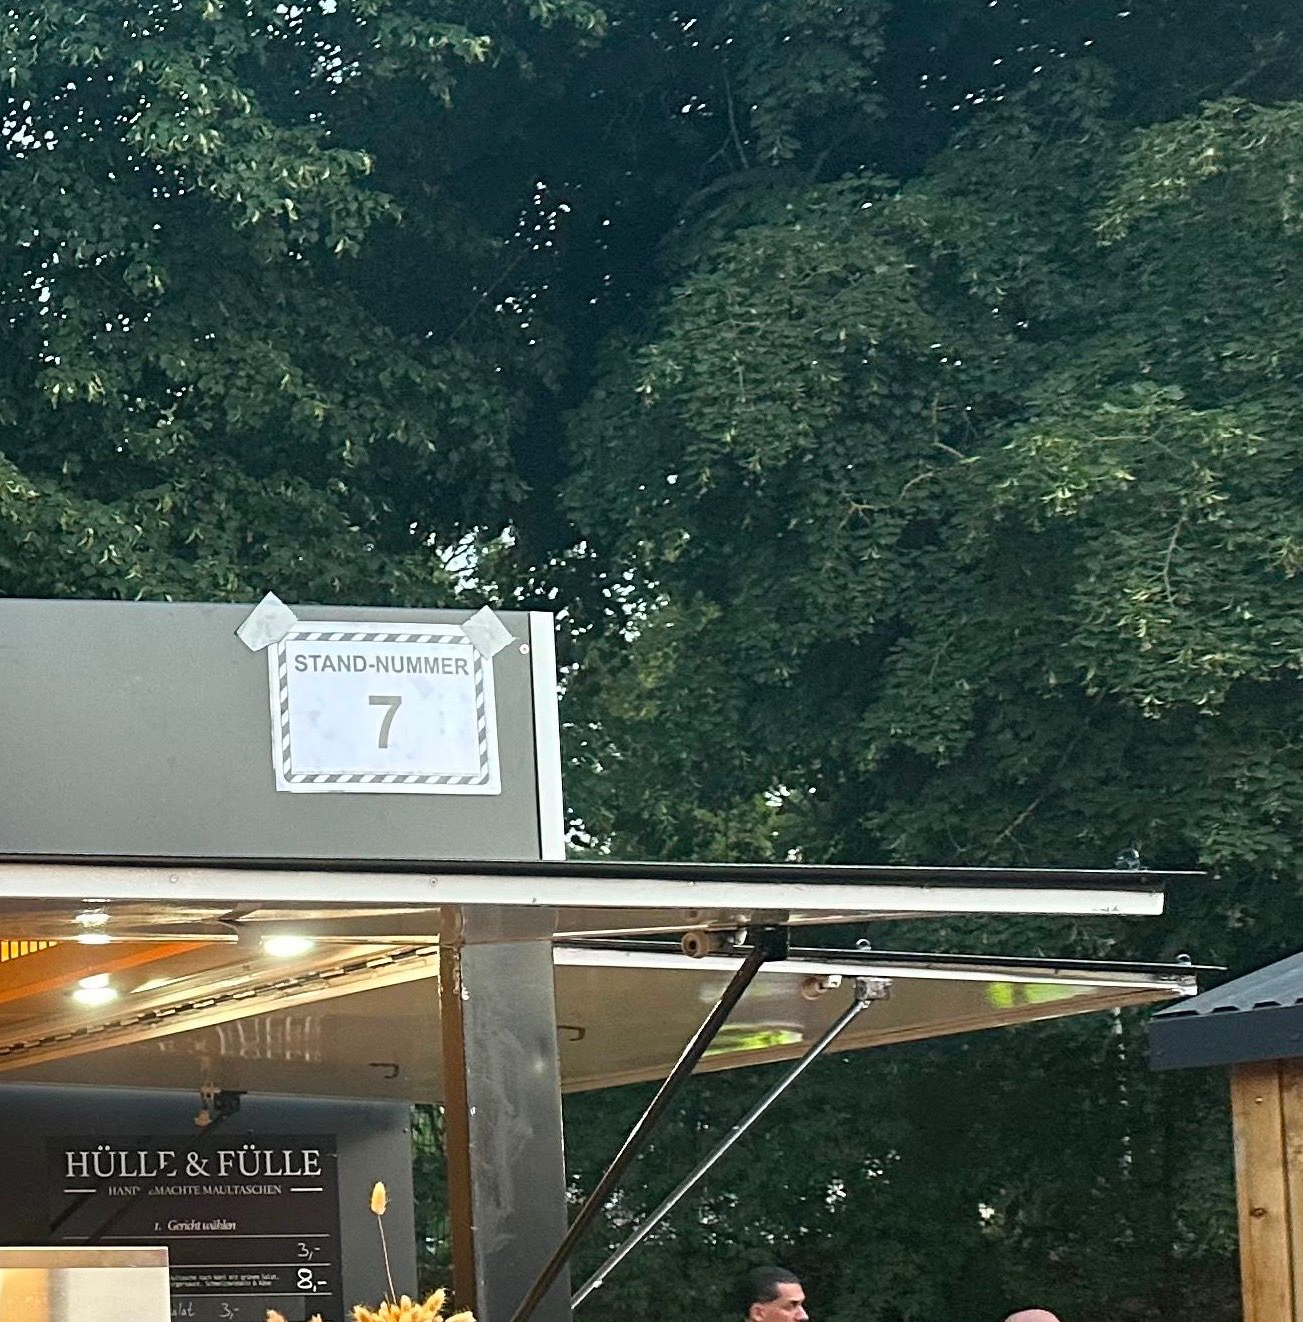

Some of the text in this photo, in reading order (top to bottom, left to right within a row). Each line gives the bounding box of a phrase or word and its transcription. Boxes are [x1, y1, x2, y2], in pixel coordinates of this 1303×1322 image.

[294, 653, 470, 676] STAND-NUMMER
[368, 695, 402, 748] 7
[65, 1143, 322, 1178] HÜLLE & FÜLLE
[202, 1183, 282, 1195] MAULTASCHEN
[167, 1218, 202, 1232] Gericht
[297, 1267, 328, 1293] 8,-
